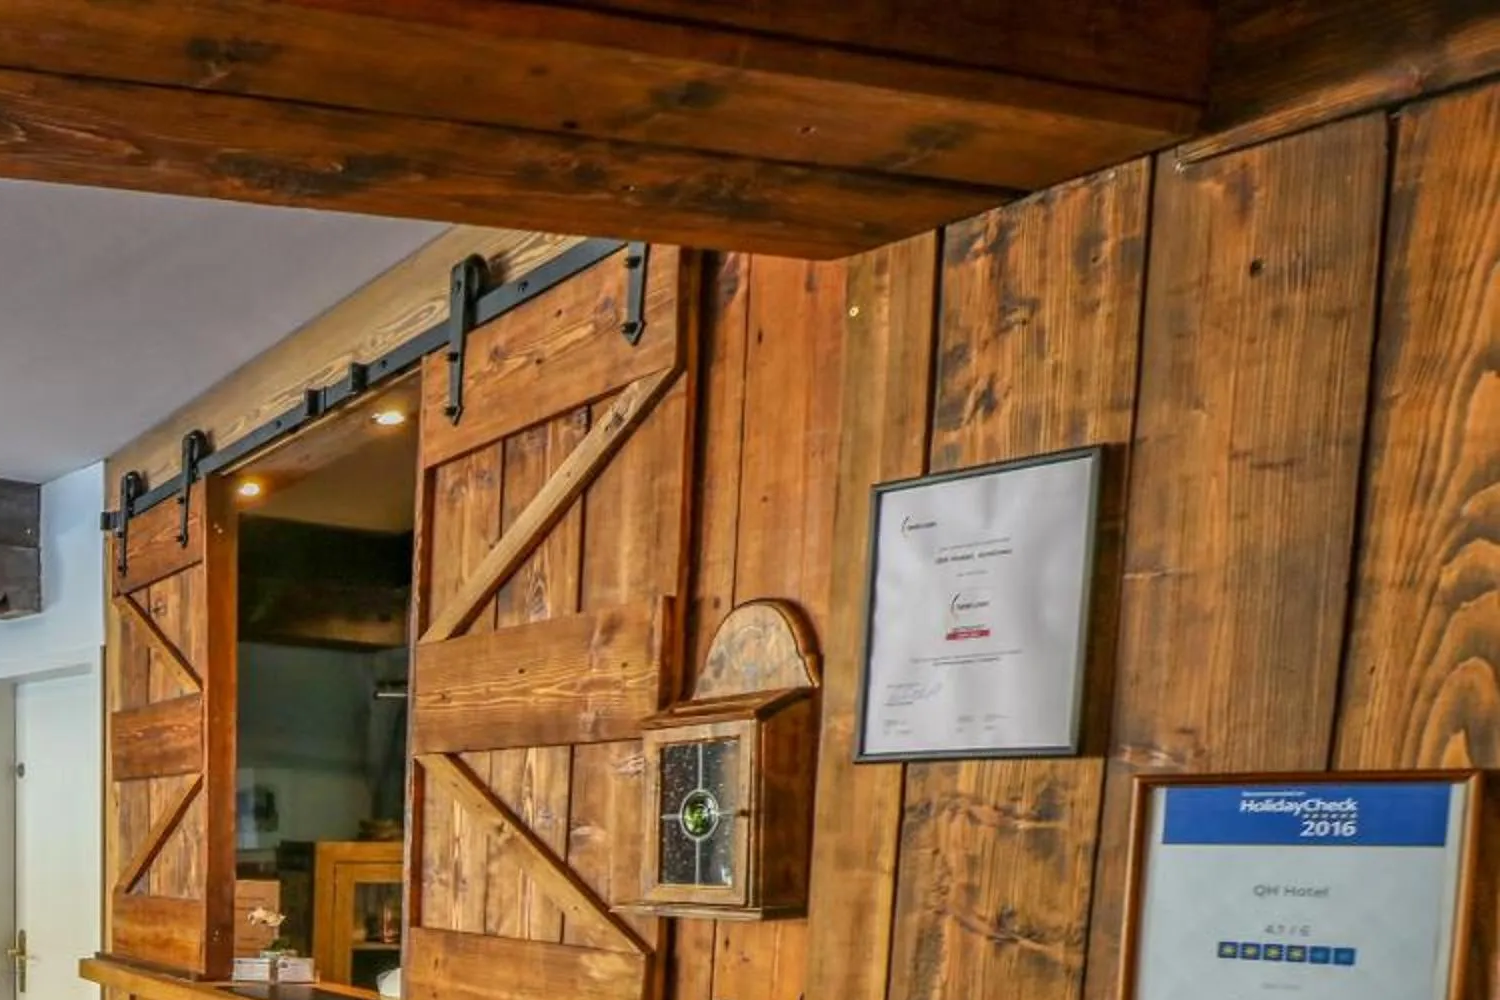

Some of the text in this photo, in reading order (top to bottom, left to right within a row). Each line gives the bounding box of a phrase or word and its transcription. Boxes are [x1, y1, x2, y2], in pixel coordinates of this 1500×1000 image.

[1240, 797, 1358, 817] HolidayCheck
[1300, 820, 1357, 838] 2016
[1283, 885, 1330, 898] Hotel
